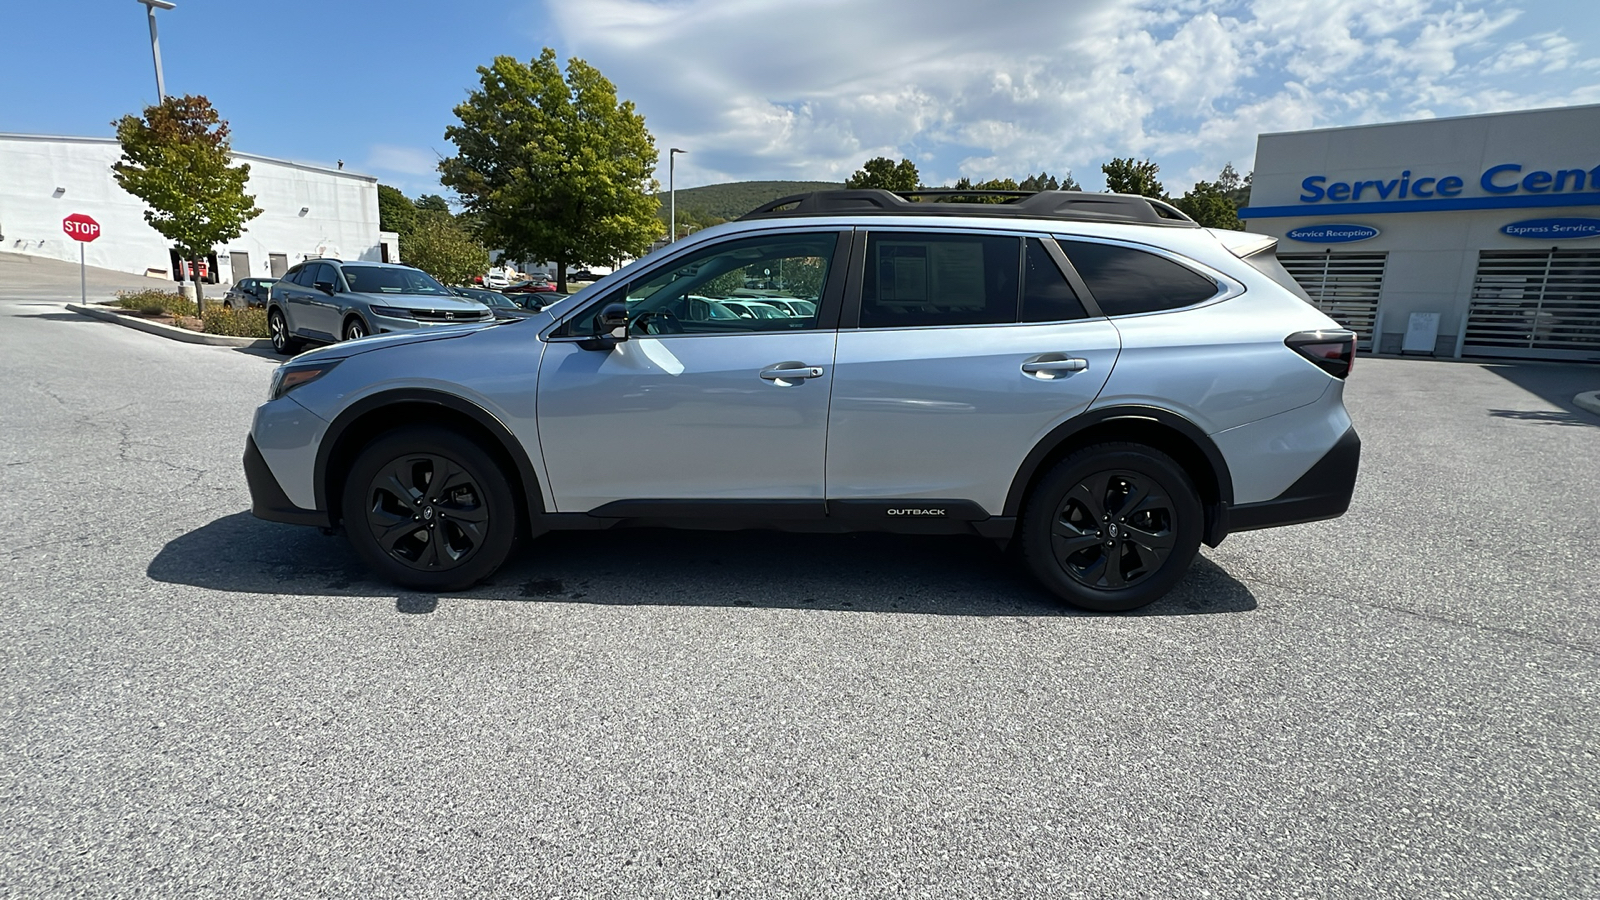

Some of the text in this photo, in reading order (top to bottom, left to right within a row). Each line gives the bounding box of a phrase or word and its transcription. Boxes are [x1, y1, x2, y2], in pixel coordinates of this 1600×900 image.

[1300, 170, 1464, 203] Service
[65, 220, 99, 235] STOP
[1291, 229, 1373, 238] Service Reception
[1506, 224, 1596, 235] Express Service
